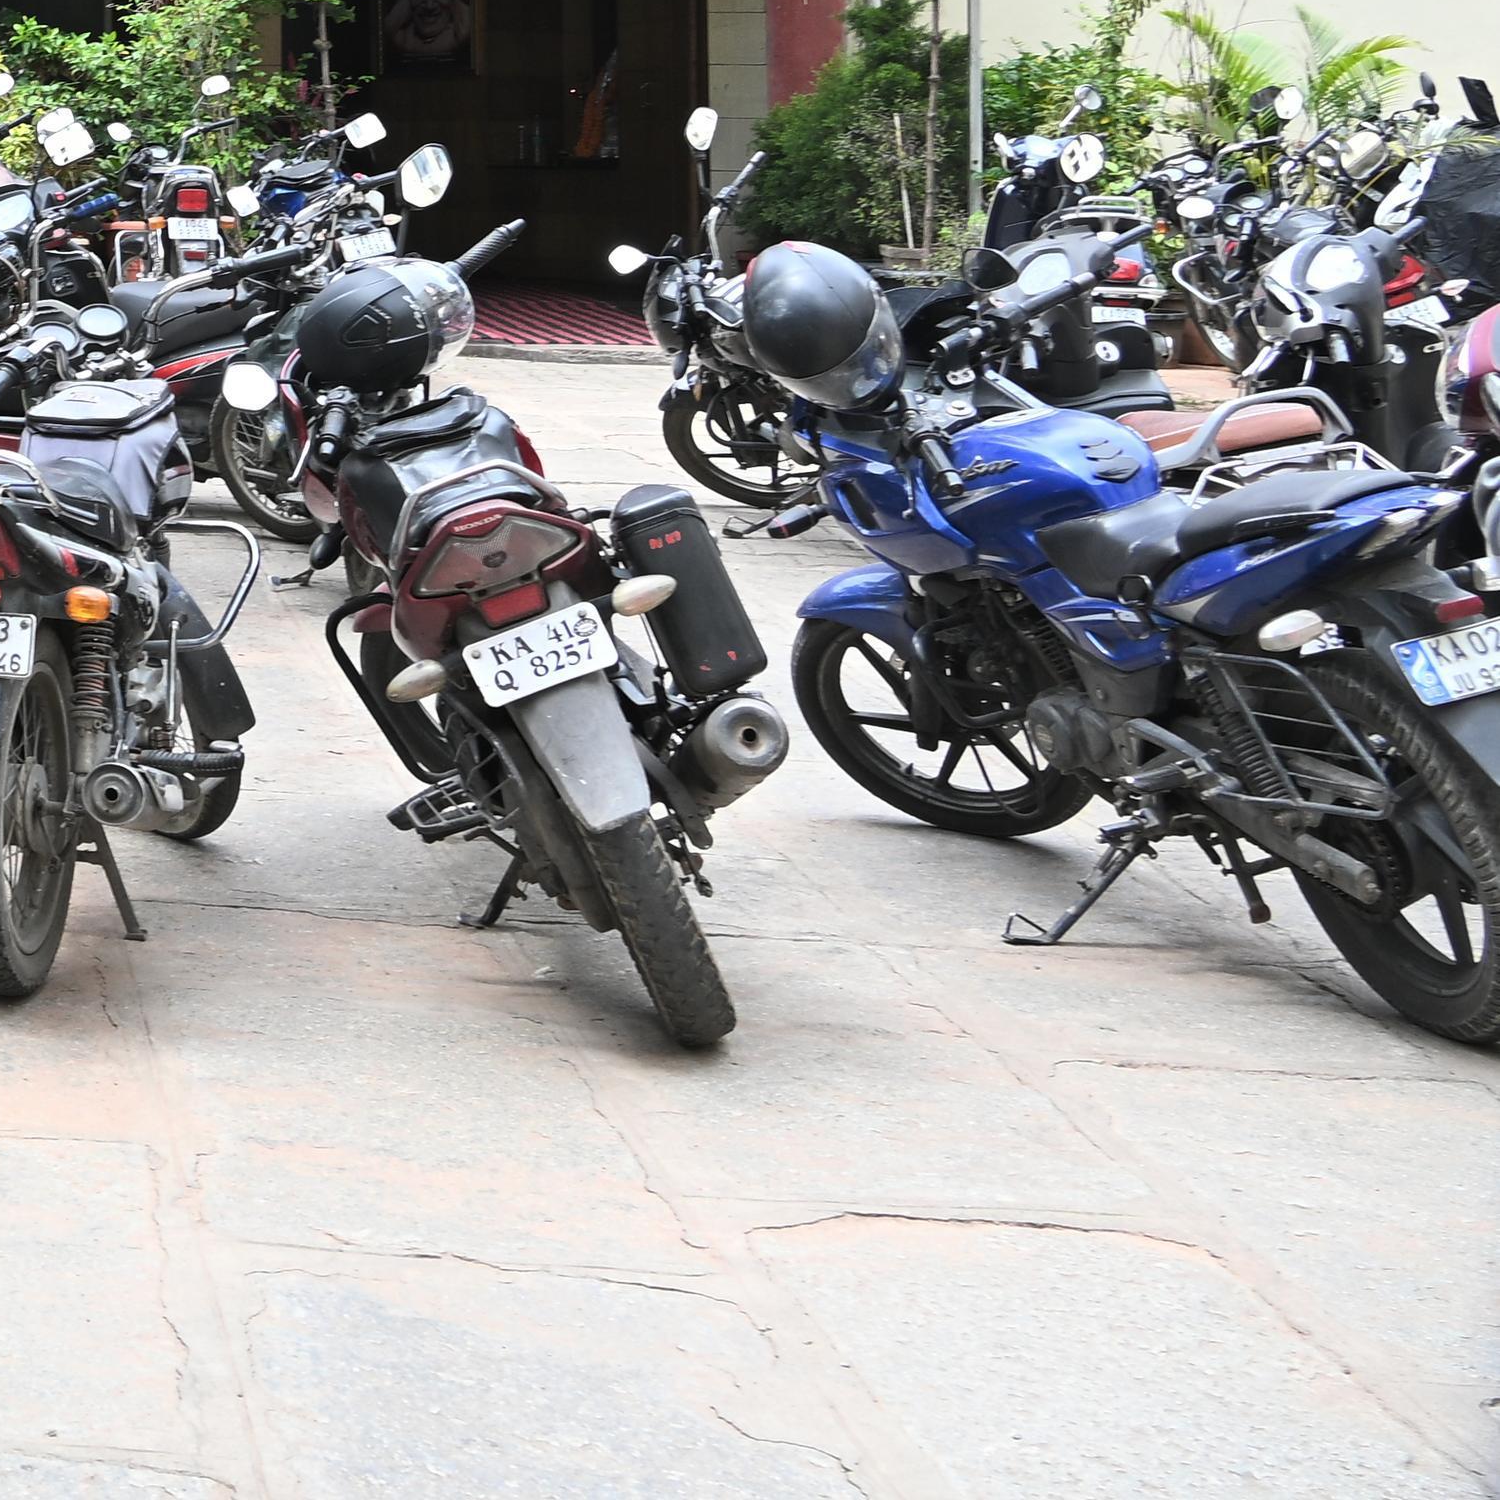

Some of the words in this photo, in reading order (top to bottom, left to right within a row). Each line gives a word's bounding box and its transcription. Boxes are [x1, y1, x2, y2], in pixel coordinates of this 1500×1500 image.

[490, 636, 533, 665] KA
[494, 670, 519, 692] Q
[530, 638, 594, 678] 8257
